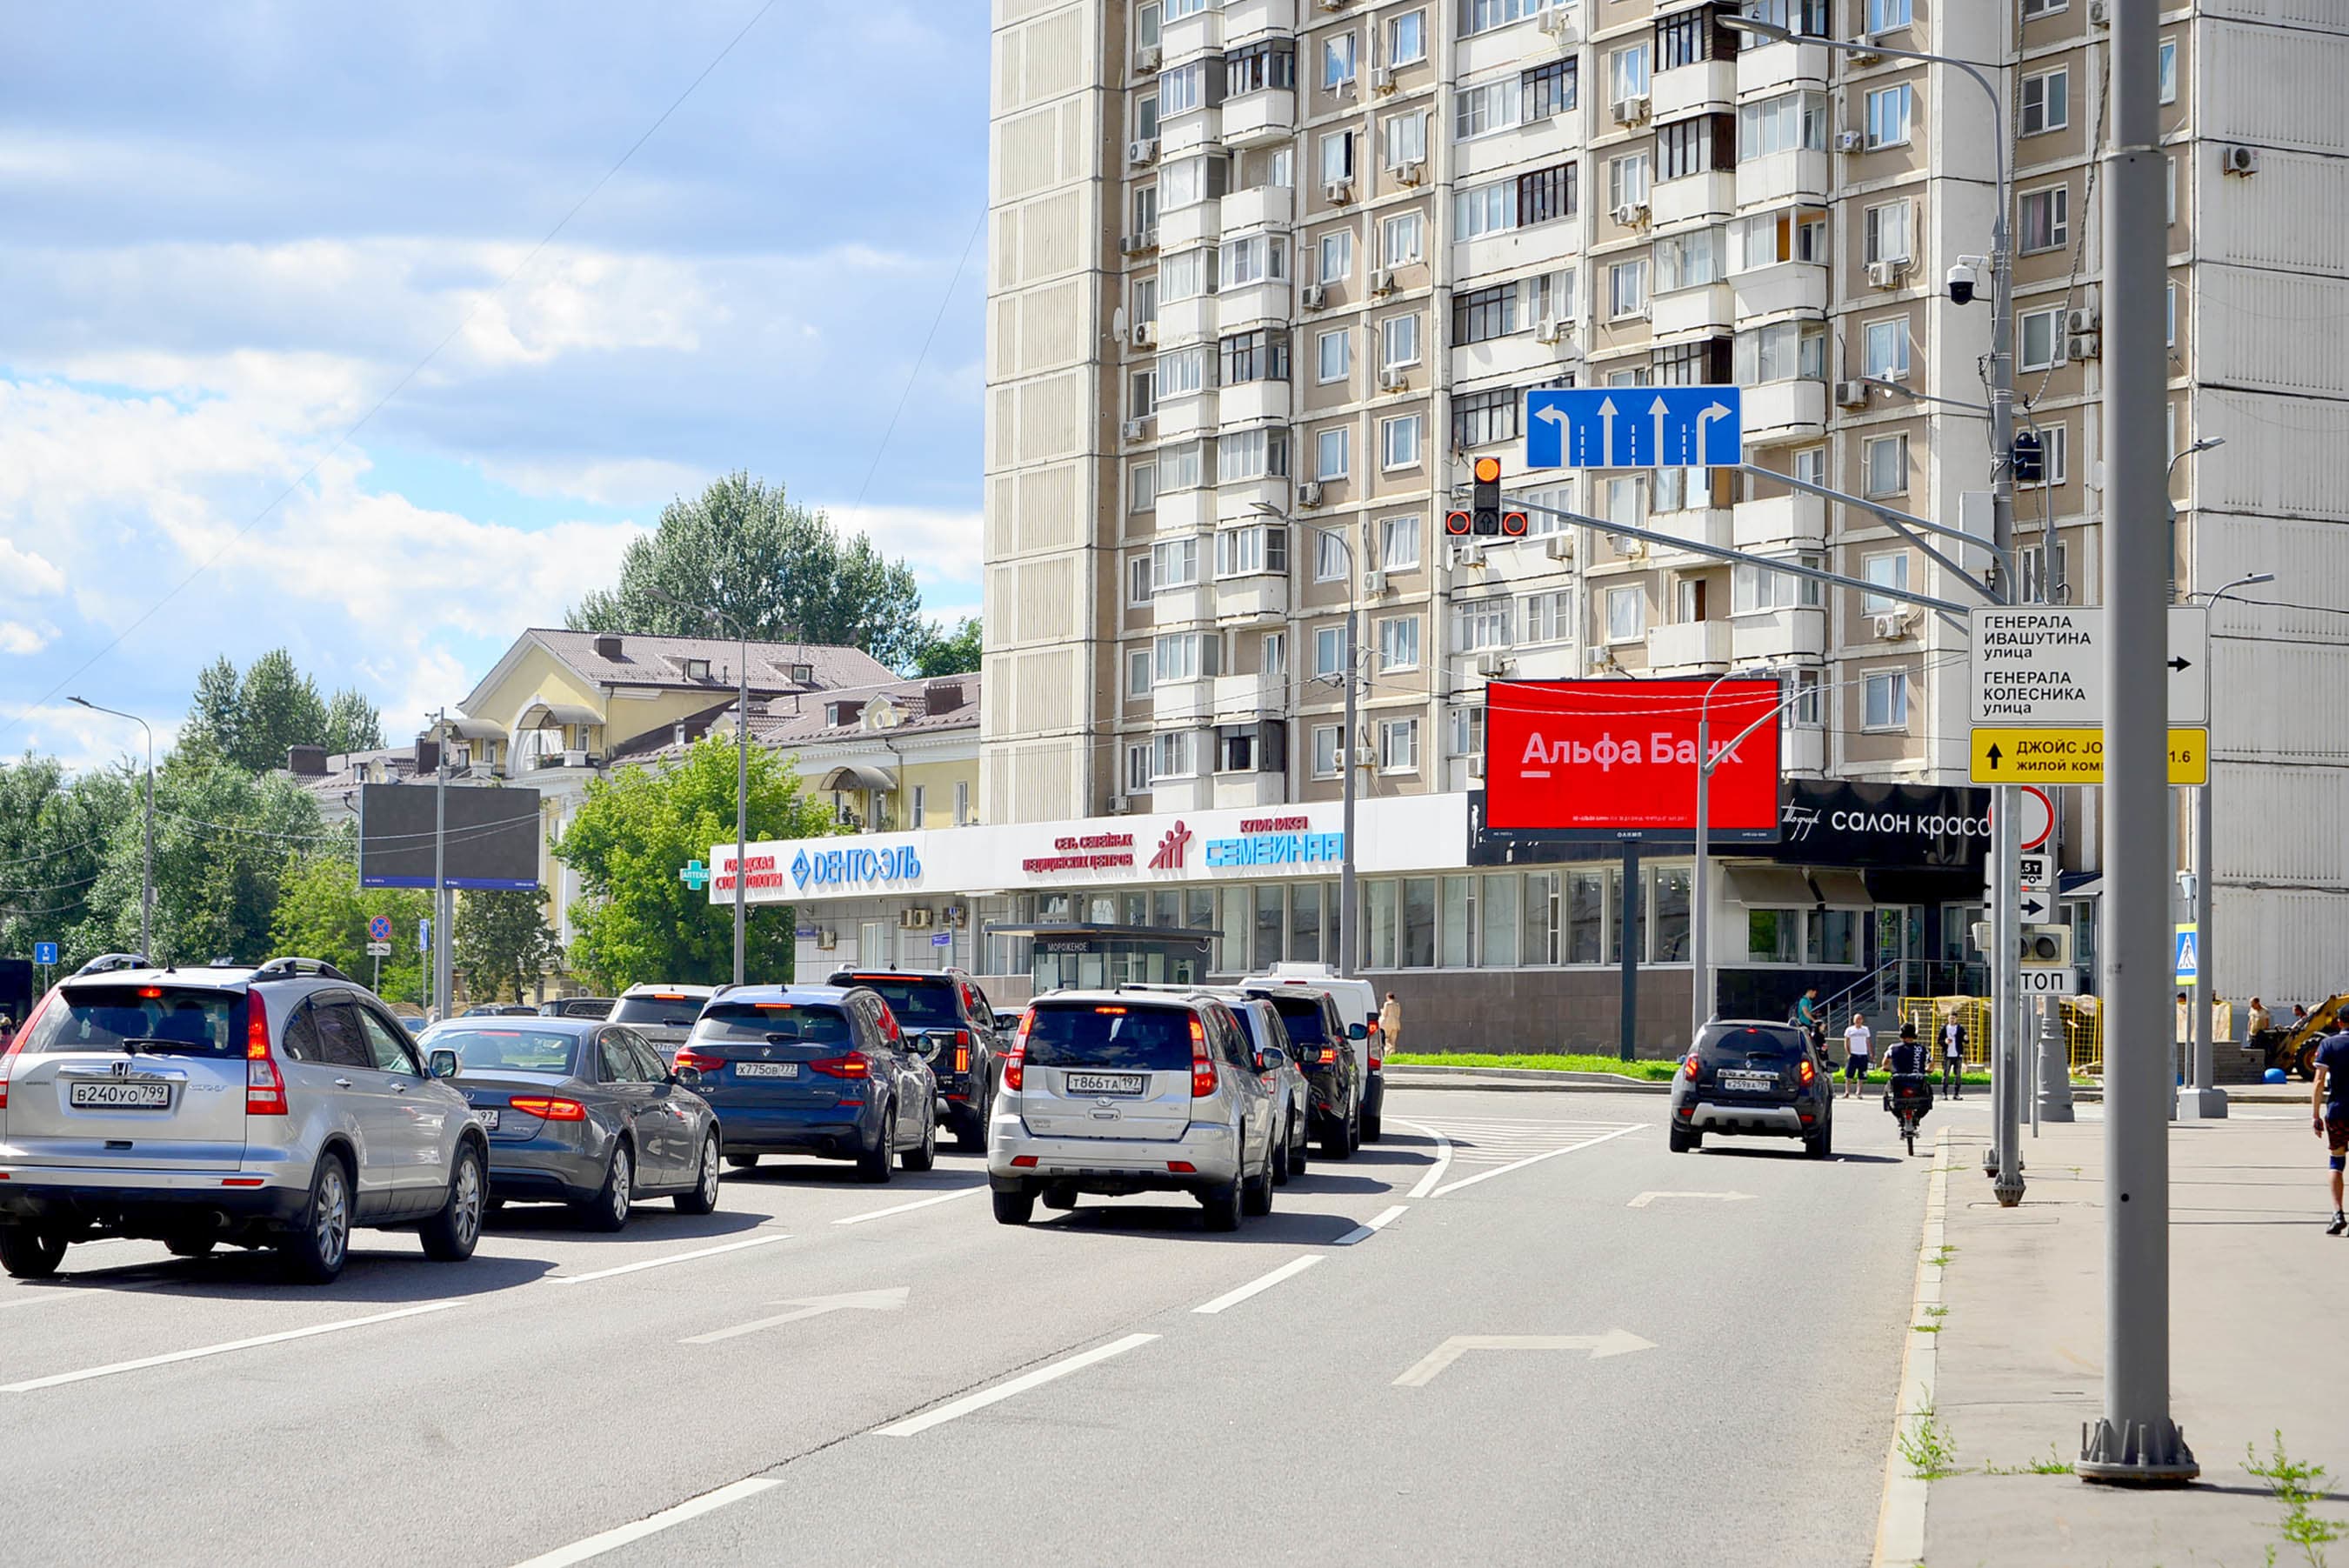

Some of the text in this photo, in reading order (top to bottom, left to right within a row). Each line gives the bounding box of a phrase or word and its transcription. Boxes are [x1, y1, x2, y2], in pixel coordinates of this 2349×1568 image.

[1985, 617, 2072, 628] ГЕНЕРАЛА
[1984, 633, 2091, 644] ИВАШУТИНА
[1984, 649, 2032, 661] улица
[1984, 672, 2072, 684] ГЕНЕРАЛА
[1984, 688, 2085, 700] КОЛЕСНИКА
[1984, 704, 2032, 717] улица
[1521, 732, 1743, 772] Альфа Банк
[2016, 739, 2103, 755] ДЖОЙС JO
[2016, 759, 2103, 771] жилой ком
[1240, 816, 1308, 833] КЛИНИКА
[1831, 811, 1909, 833] салон
[1055, 837, 1078, 851] СЕТЬ
[724, 856, 774, 872] ГОРДСКАЯ
[716, 873, 783, 890] СТОМТОЛОГИЯ
[1047, 942, 1087, 951] МОРОЖЕНОЕ
[2021, 973, 2064, 991] ТОП
